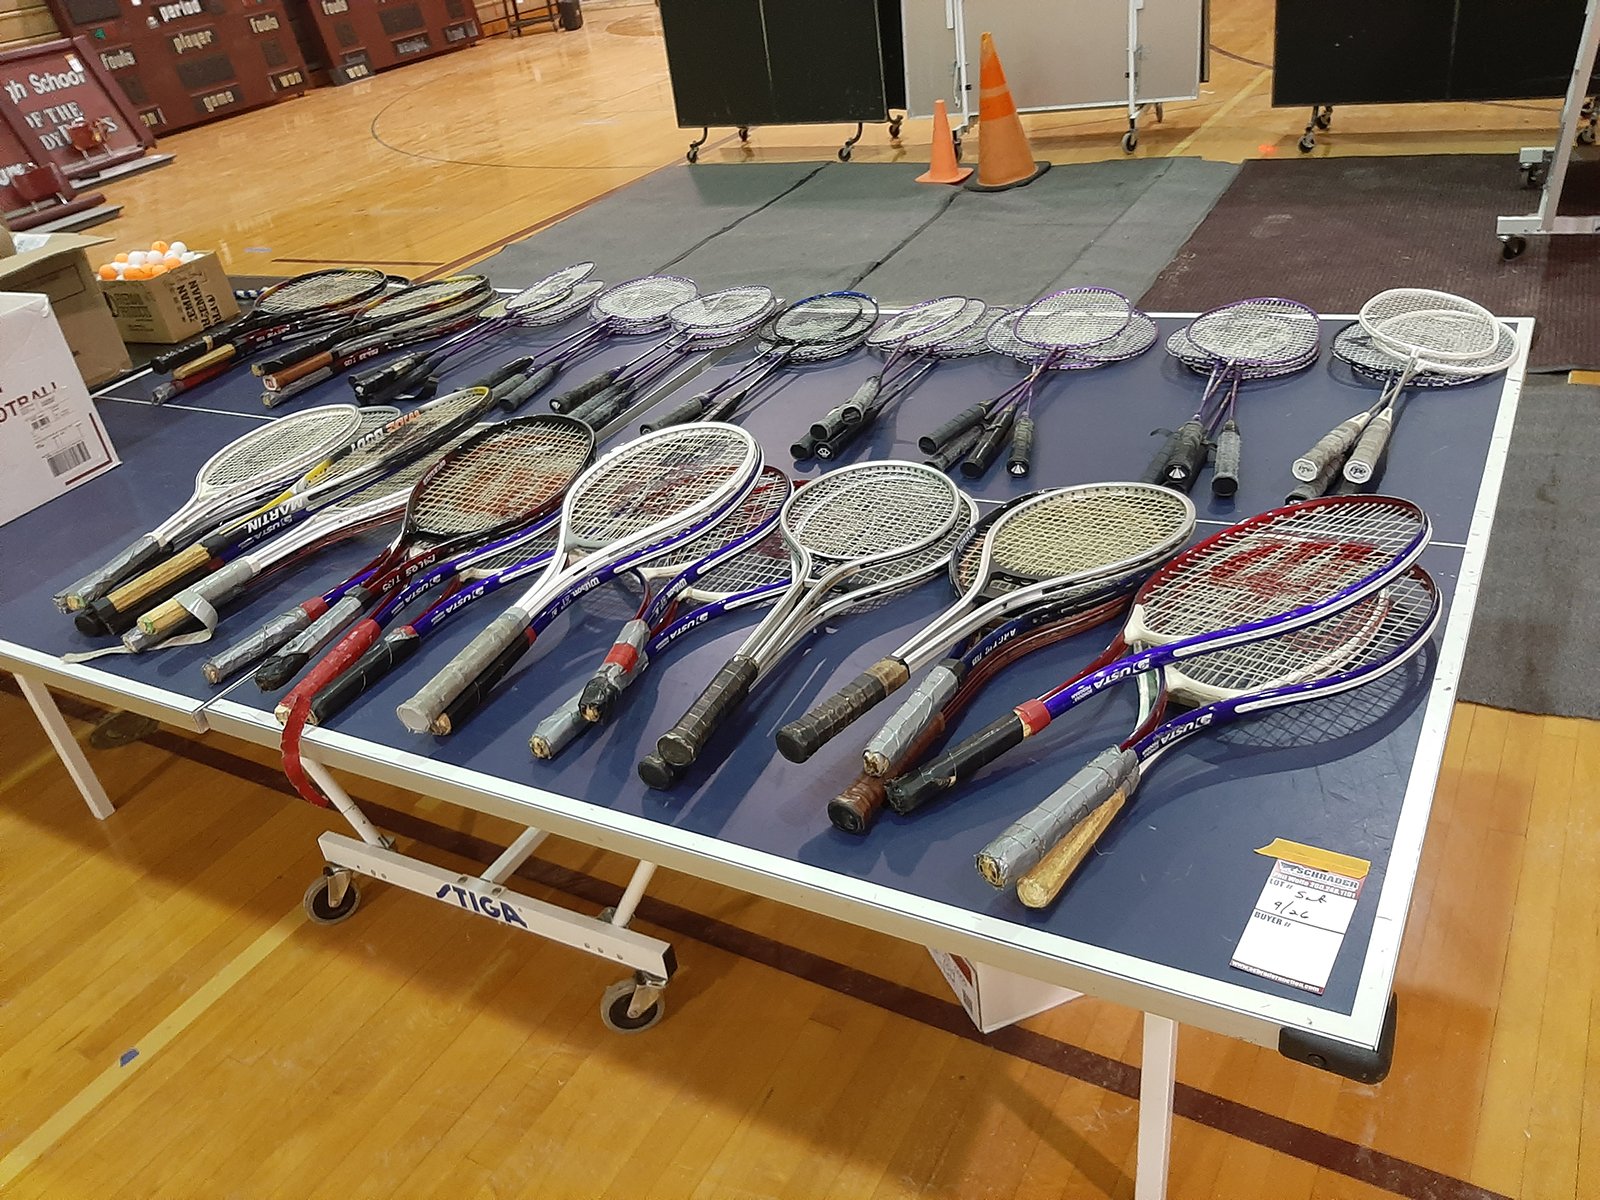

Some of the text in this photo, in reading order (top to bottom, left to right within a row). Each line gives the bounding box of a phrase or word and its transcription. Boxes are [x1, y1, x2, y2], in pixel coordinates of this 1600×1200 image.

[159, 0, 202, 23] period
[173, 30, 213, 54] player
[43, 102, 83, 122] THE
[203, 91, 235, 113] game
[405, 580, 433, 602] USTA
[571, 578, 600, 597] Wilson
[447, 590, 477, 614] USTA
[669, 618, 696, 640] USTA
[1093, 667, 1132, 690] USTA
[1160, 719, 1196, 746] USTA
[1269, 879, 1283, 887] LOT
[1296, 868, 1358, 888] SCHRADER
[436, 884, 528, 928] STIGA
[1254, 912, 1282, 924] BUYER
